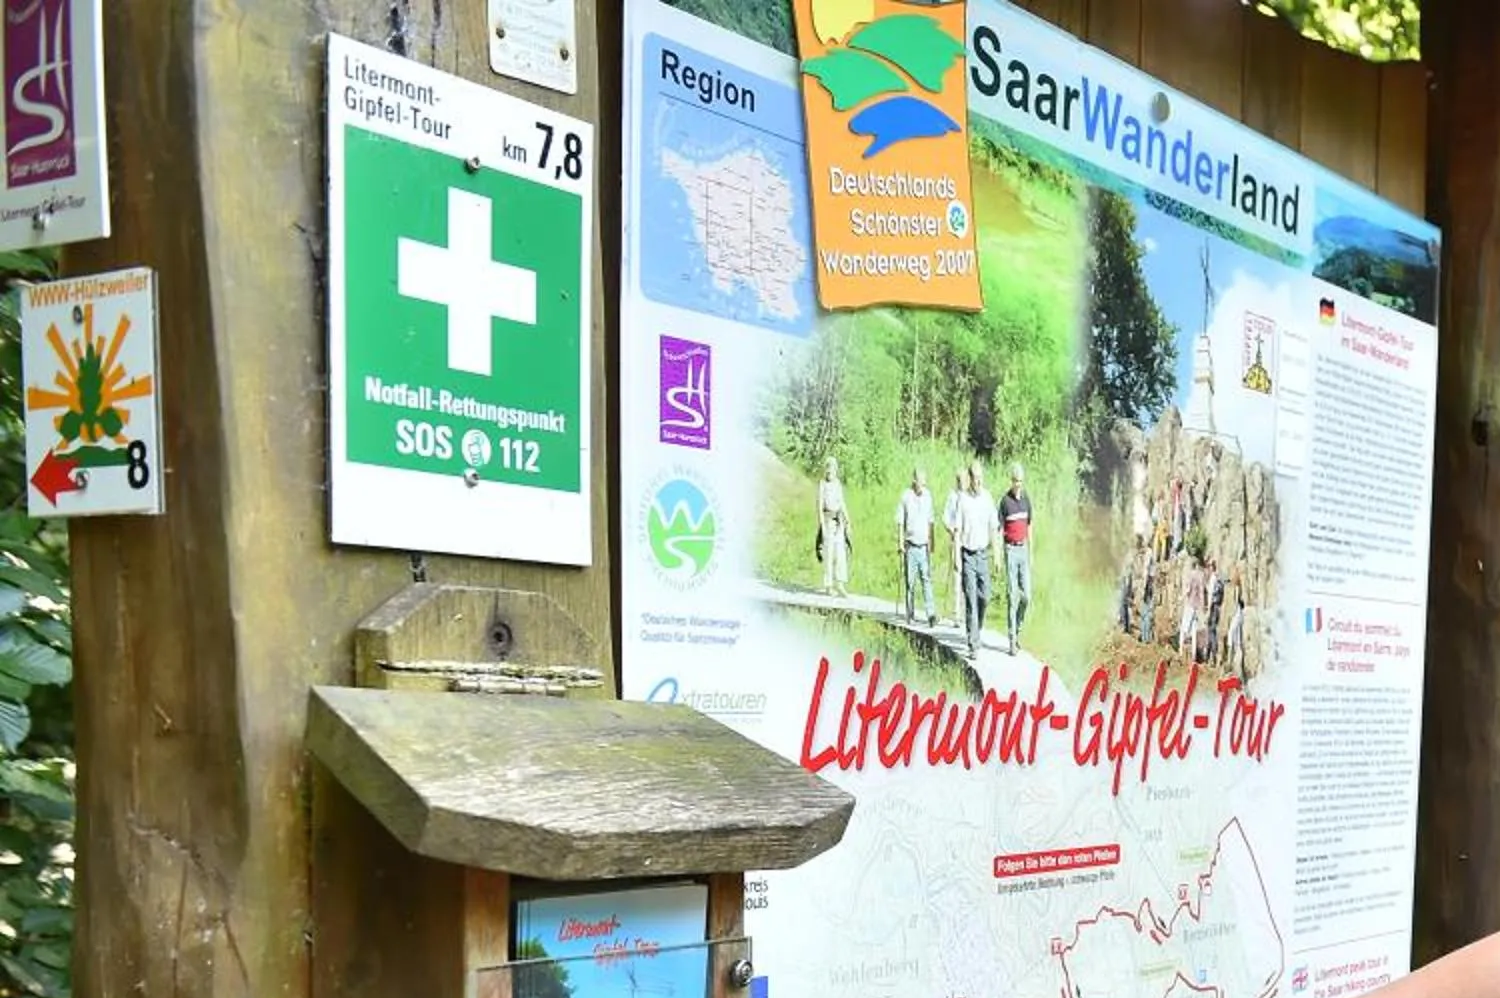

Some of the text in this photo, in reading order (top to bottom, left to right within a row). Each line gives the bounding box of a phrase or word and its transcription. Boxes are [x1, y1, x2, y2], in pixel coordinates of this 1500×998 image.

[344, 55, 441, 107] Litermont-
[660, 48, 756, 112] Region
[344, 85, 452, 141] Gipfel-Tour
[971, 24, 1300, 237] SaarWanderland
[502, 121, 584, 181] km 7,8
[829, 166, 956, 199] Deutschlands
[850, 209, 943, 238] Schönster
[820, 248, 975, 280] Wanderweg 2007
[364, 375, 566, 434] Notfall-Rettungspunkt
[127, 439, 150, 490] 8
[396, 420, 541, 473] SOS 112
[799, 651, 1285, 797] Litermont-Gipfel-Tour
